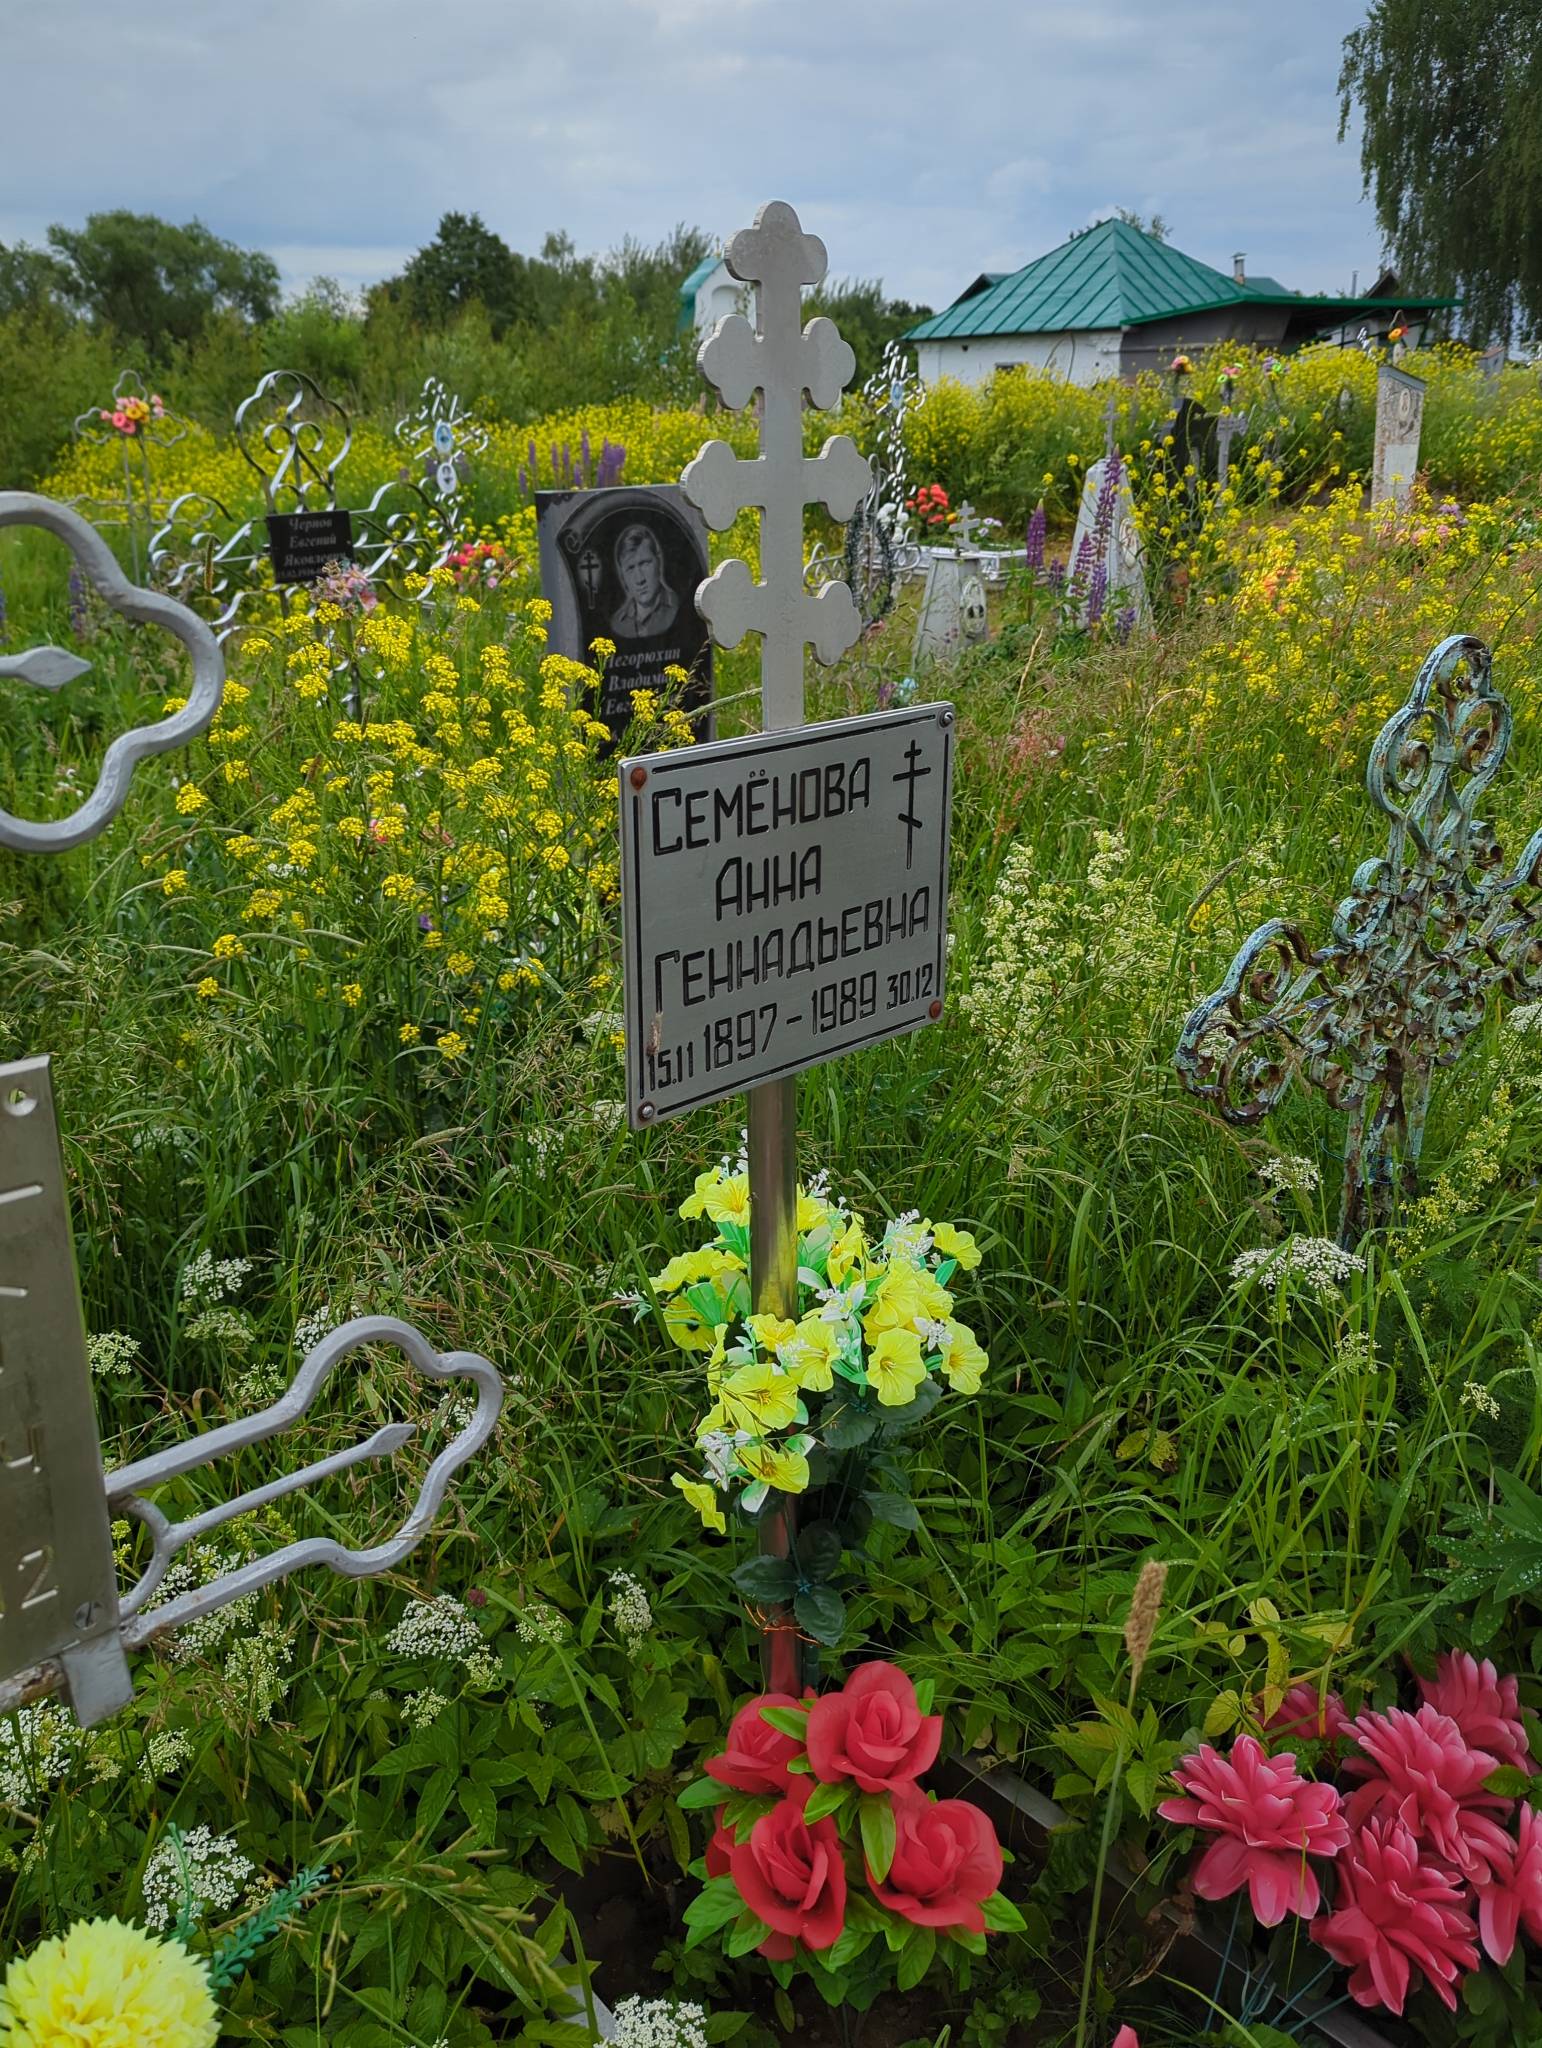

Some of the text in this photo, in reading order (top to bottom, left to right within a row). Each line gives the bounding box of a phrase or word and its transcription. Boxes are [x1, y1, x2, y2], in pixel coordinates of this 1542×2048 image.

[289, 533, 337, 549] Евгений
[651, 757, 871, 856] СЕМЁНОВА
[715, 844, 822, 922] АННА
[654, 885, 930, 1013] ГЕННАДЬЕВНА
[703, 1002, 777, 1072] 1897
[811, 970, 877, 1036] 1989
[886, 963, 933, 1011] 30.12
